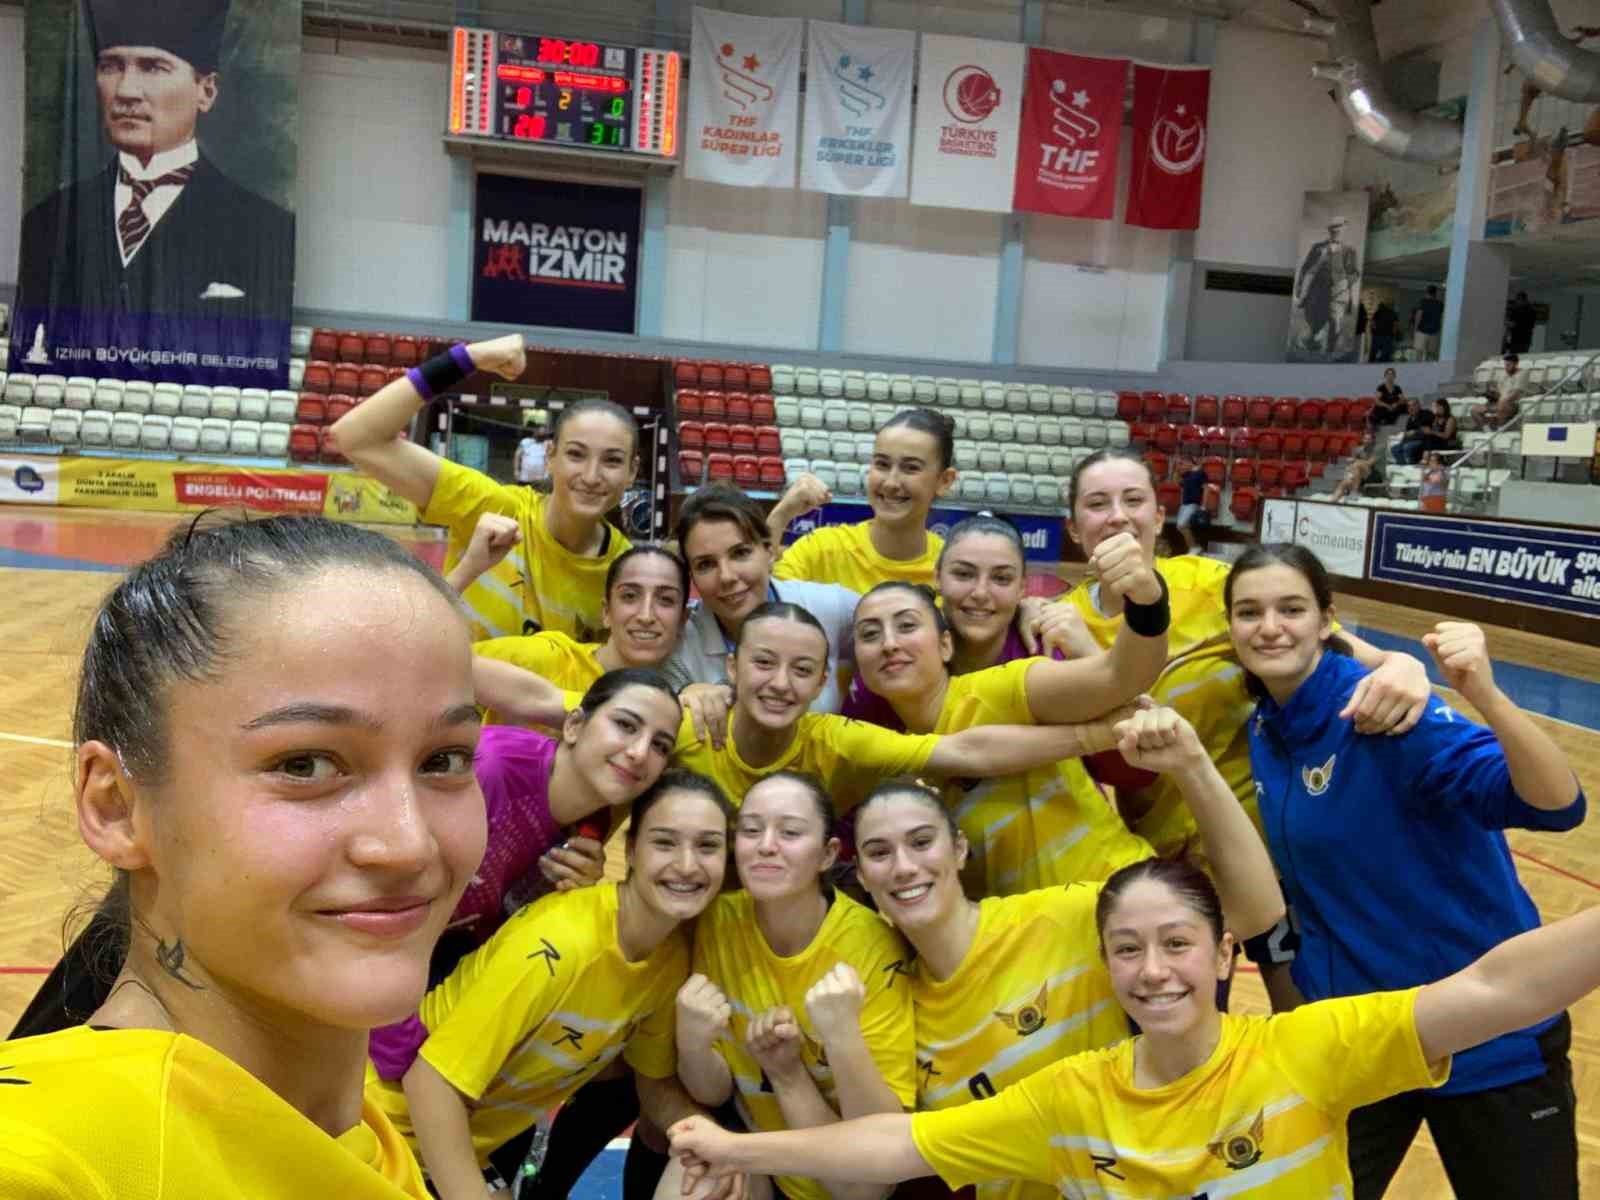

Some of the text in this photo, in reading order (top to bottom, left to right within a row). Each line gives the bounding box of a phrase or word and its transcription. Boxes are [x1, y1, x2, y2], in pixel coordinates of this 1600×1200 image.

[559, 92, 571, 110] 2
[728, 115, 756, 127] THF
[846, 126, 873, 137] THF
[1040, 144, 1098, 173] THF
[483, 218, 626, 254] MARATON
[96, 346, 197, 366] BÜYÜKŞEHİR
[1396, 543, 1571, 586] Türkiye'nin EN BÜYÜK
